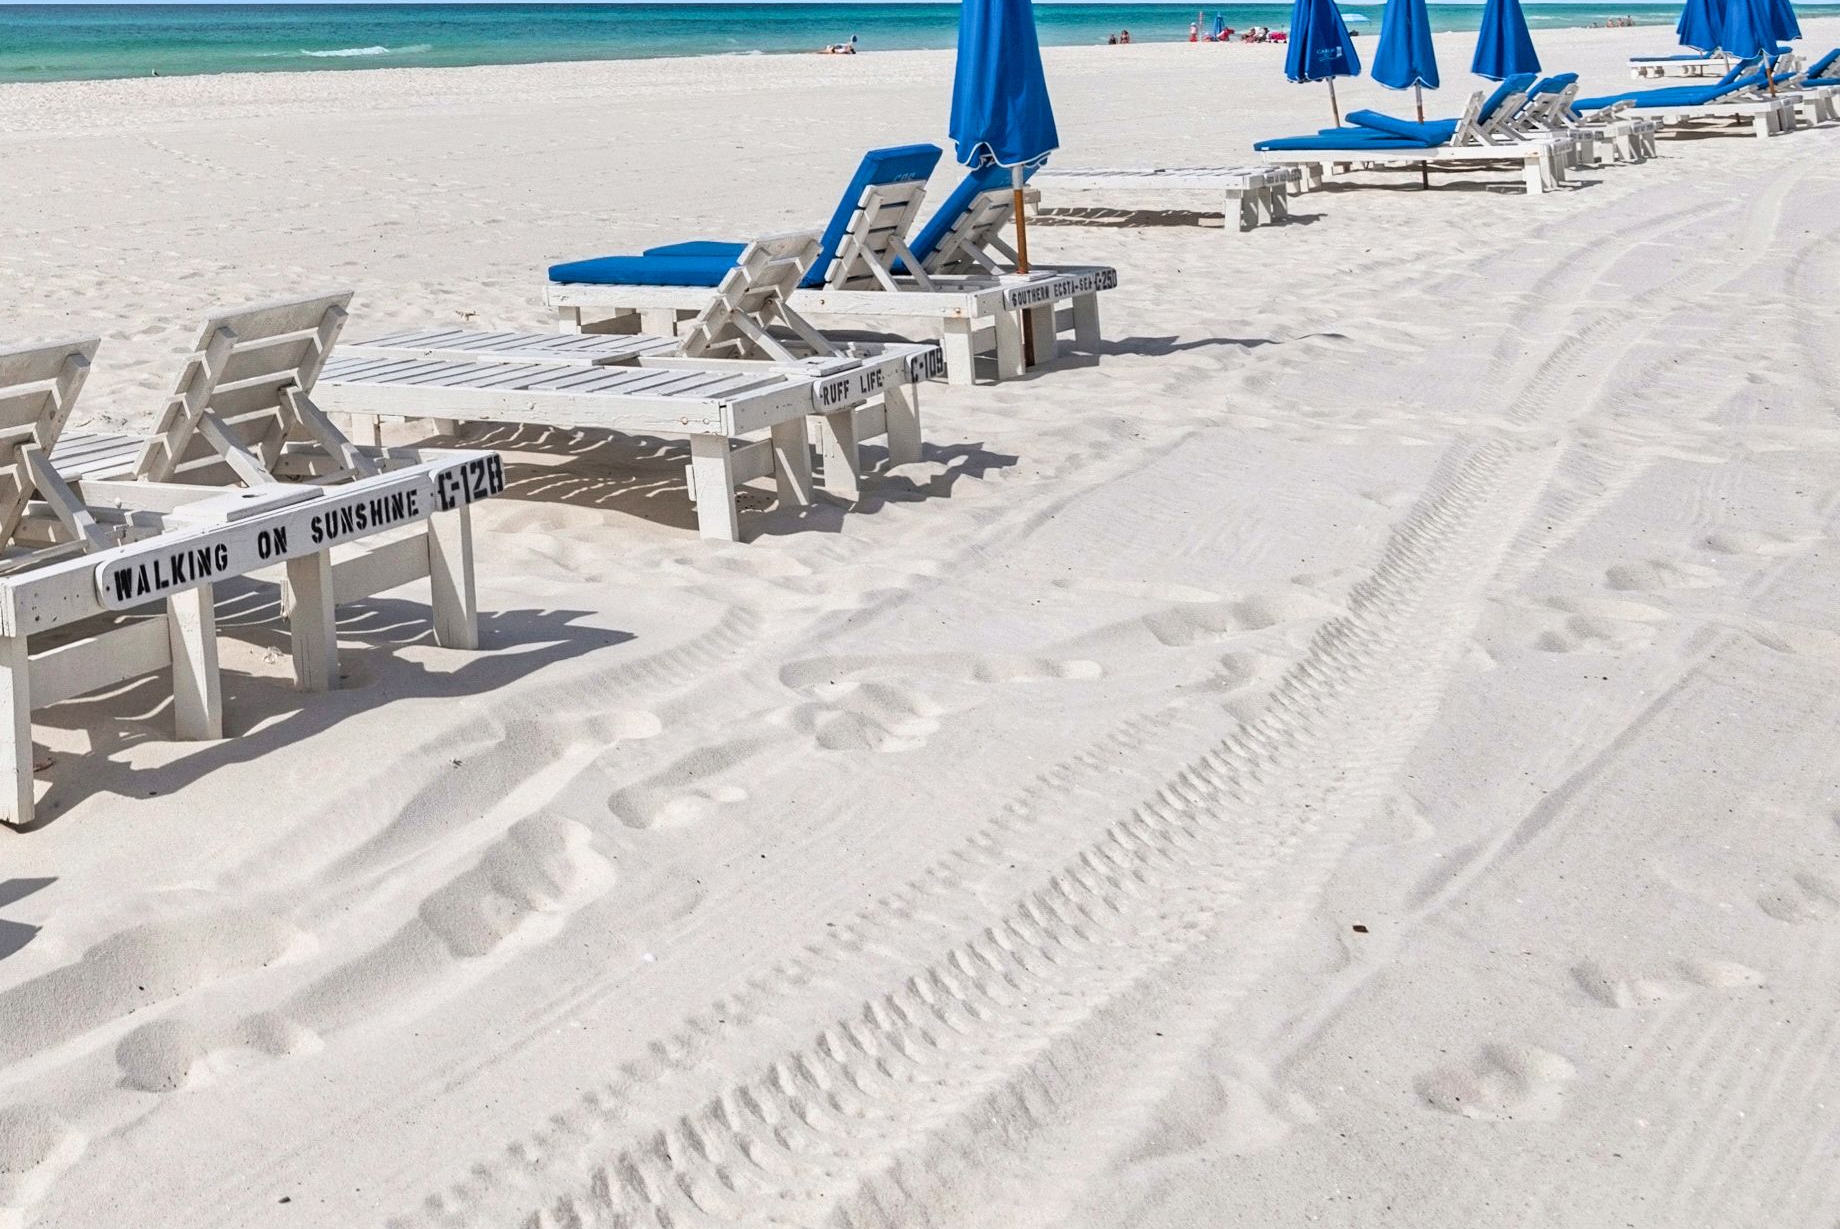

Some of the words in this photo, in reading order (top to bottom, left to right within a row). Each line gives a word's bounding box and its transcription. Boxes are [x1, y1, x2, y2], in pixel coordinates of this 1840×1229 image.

[1012, 285, 1050, 307] SOUTHERN
[910, 347, 943, 383] C-109
[822, 379, 850, 406] RUFF
[859, 369, 883, 393] LIFE
[438, 454, 504, 512] C-128
[113, 543, 229, 602] WALKING
[257, 526, 288, 560] ON
[310, 488, 420, 544] SUNSHINE
